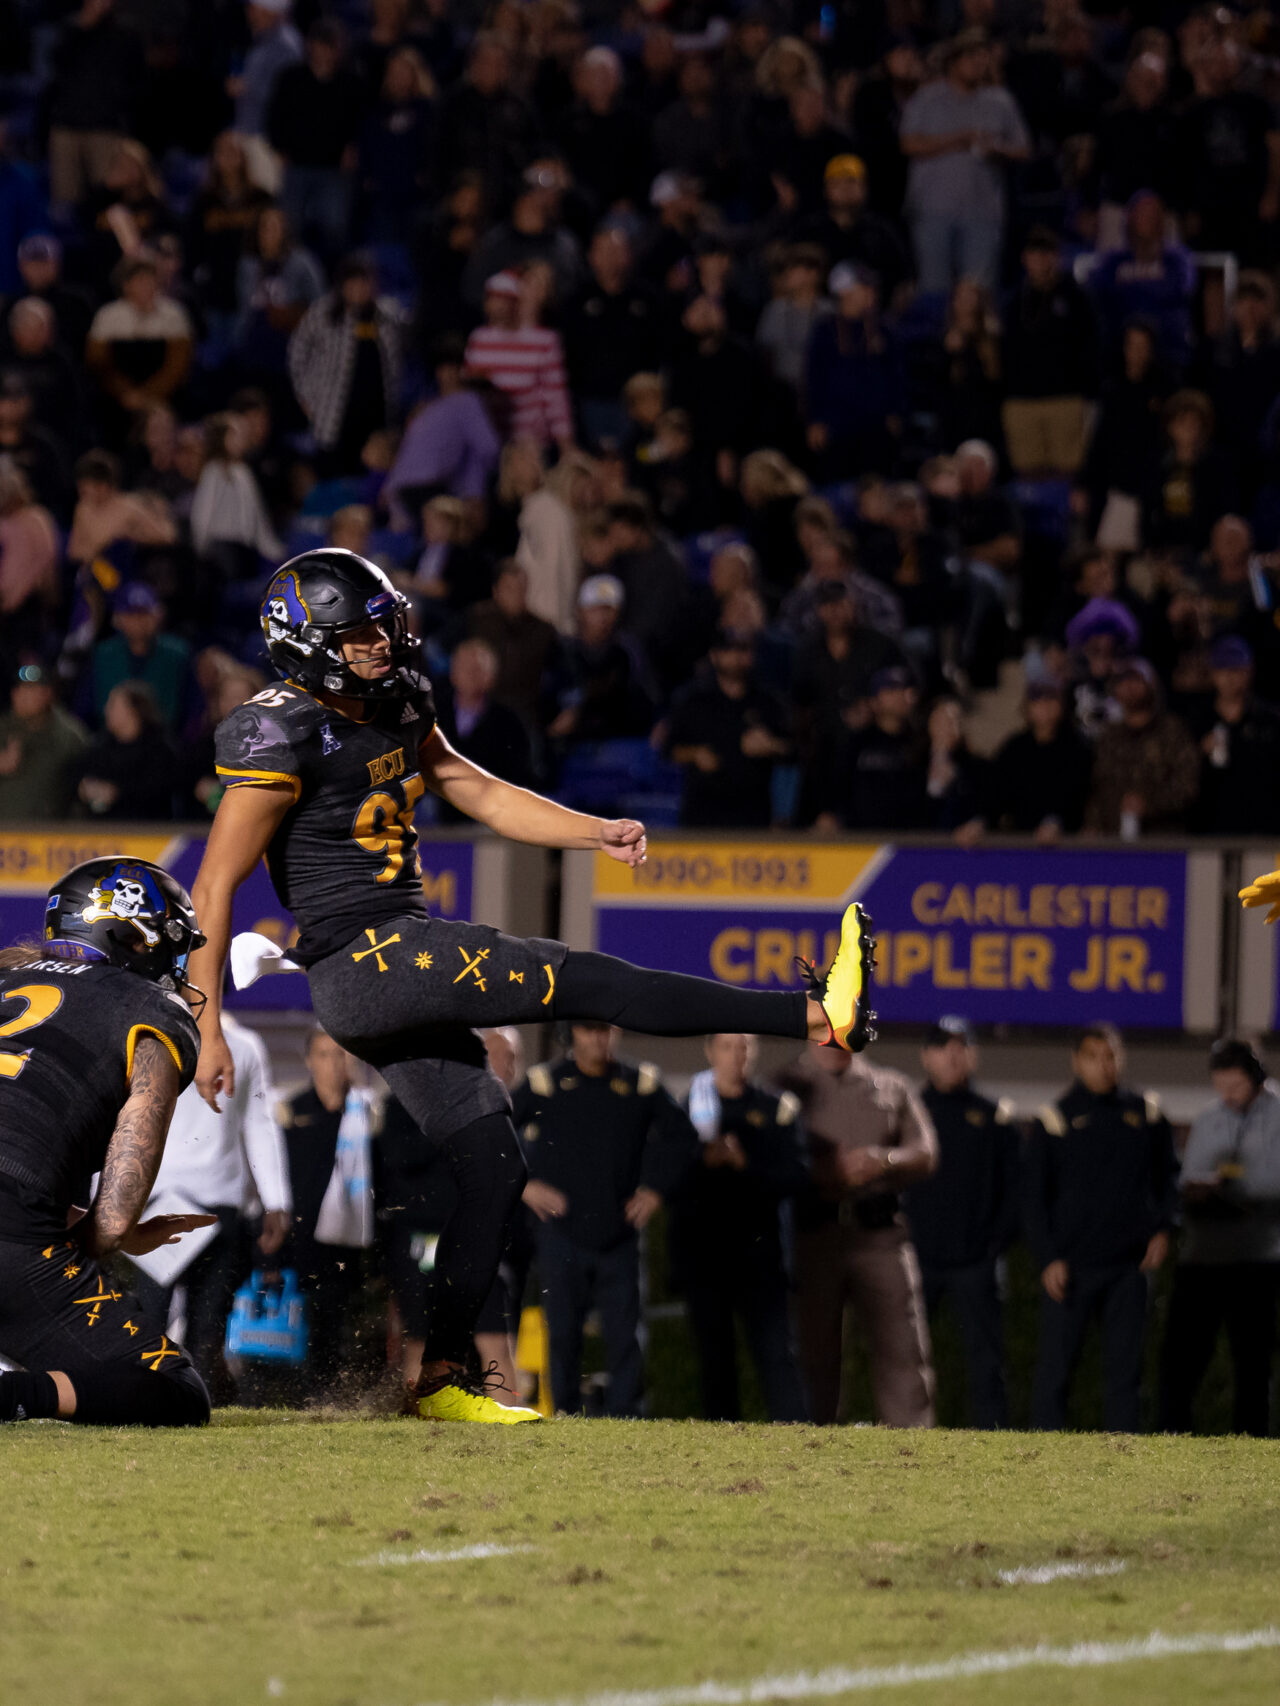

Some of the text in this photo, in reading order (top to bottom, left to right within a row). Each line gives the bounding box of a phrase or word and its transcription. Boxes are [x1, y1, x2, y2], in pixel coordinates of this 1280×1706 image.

[242, 688, 297, 707] 95
[366, 746, 406, 788] ECU
[119, 866, 145, 879] ECU
[910, 880, 1169, 930] CARLESTER
[1068, 934, 1167, 993] JR.
